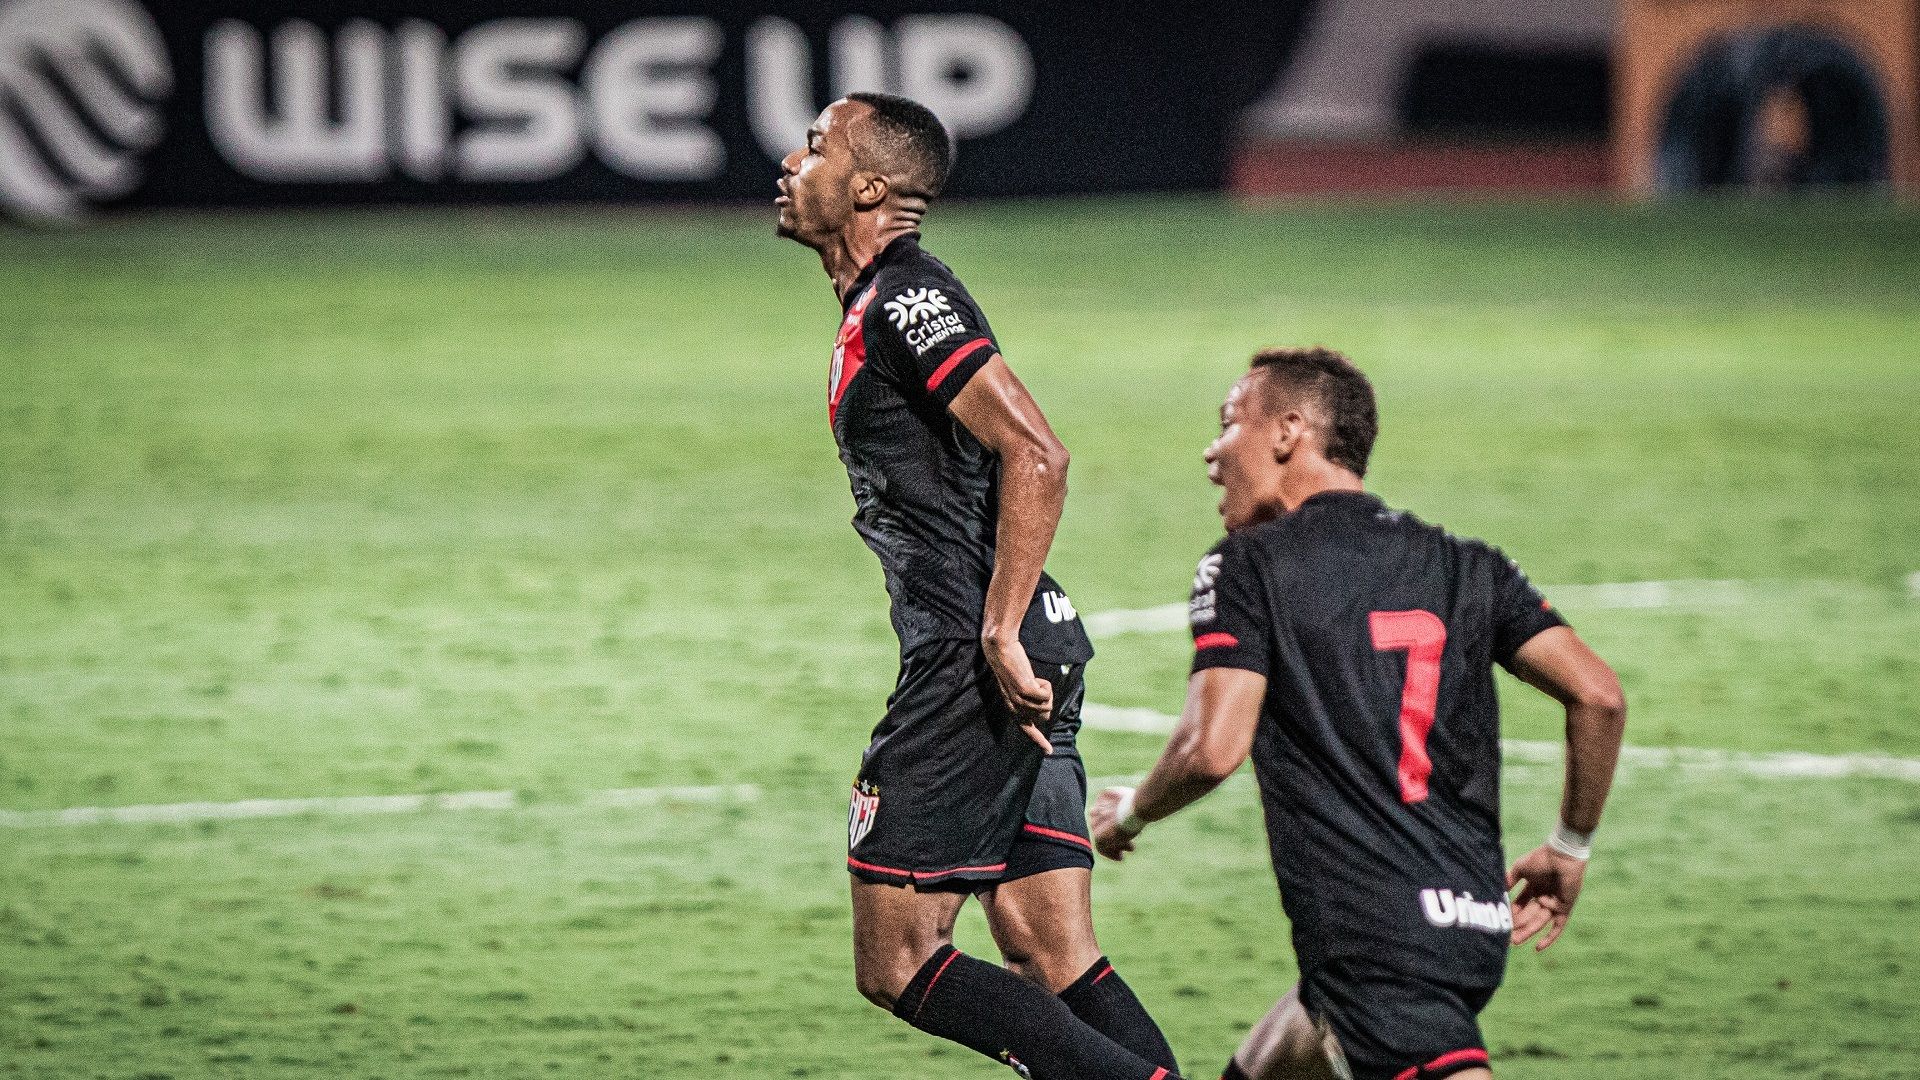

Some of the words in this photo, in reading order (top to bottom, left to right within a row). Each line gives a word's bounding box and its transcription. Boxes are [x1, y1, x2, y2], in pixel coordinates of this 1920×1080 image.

[202, 16, 728, 183] WISE
[744, 12, 1036, 166] UP
[905, 311, 962, 346] Cristal
[915, 323, 967, 356] ALIMENTOS
[1368, 609, 1448, 804] 7
